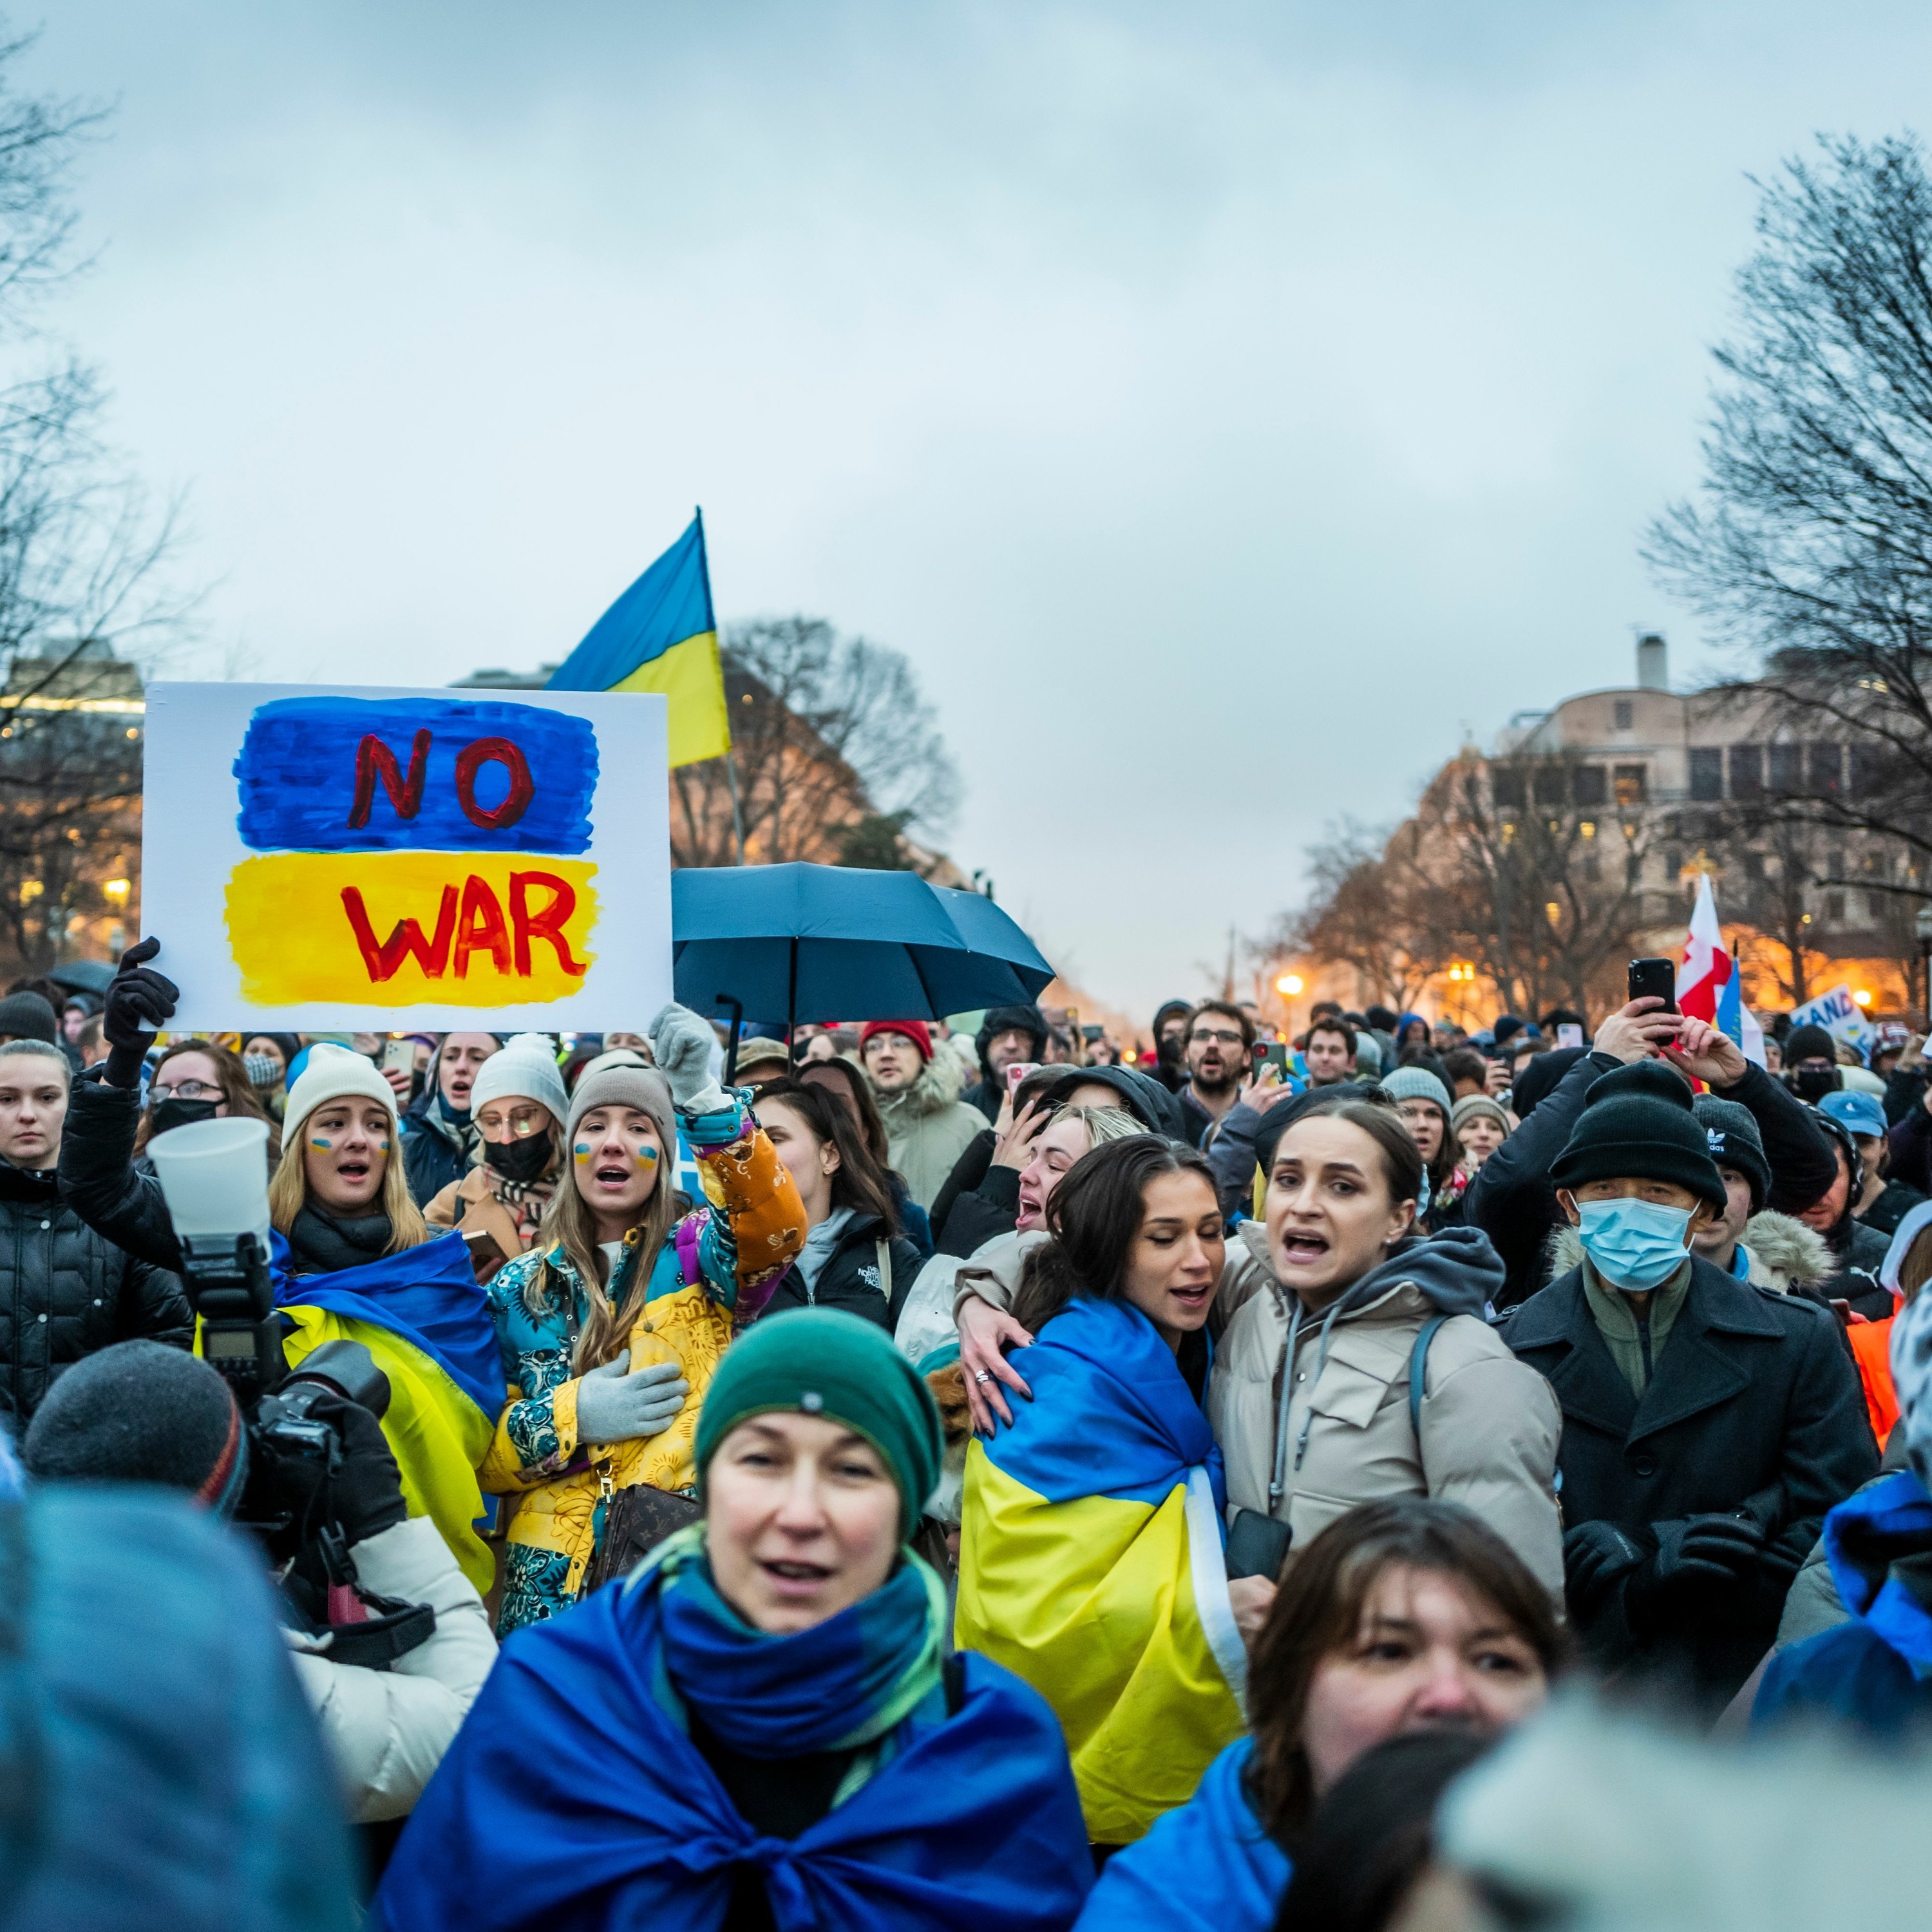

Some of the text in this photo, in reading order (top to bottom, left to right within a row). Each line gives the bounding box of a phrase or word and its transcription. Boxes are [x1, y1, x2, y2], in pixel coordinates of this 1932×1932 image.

[346, 726, 536, 831] NO
[340, 869, 587, 983] WAR
[858, 1267, 880, 1281] NORTH
[867, 1265, 880, 1275] THE
[864, 1275, 880, 1289] FACE
